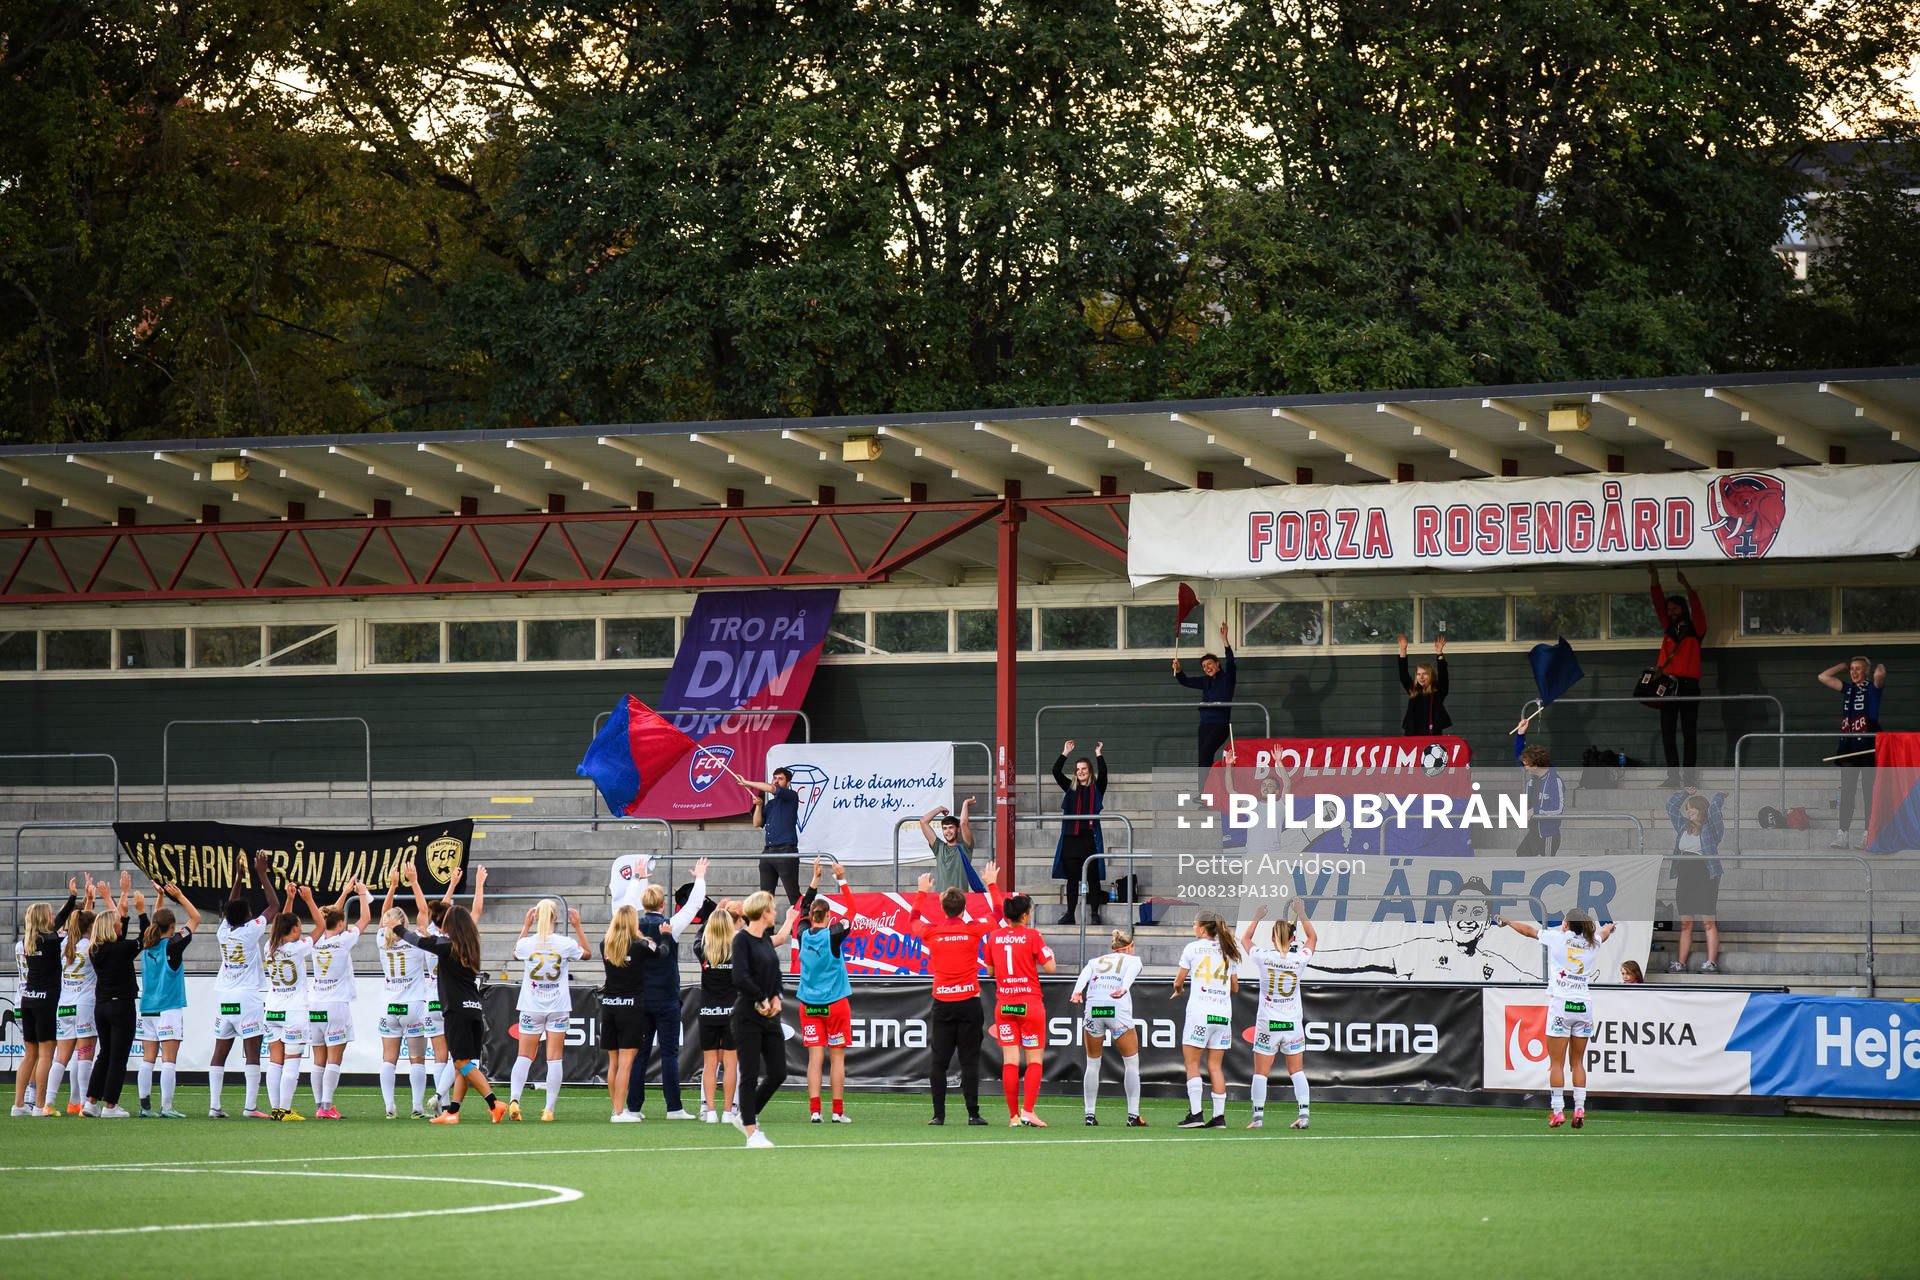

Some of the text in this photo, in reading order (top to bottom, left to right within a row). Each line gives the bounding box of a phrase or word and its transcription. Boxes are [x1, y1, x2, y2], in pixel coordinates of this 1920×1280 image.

[1248, 480, 1696, 562] FORZA ROSENGÅRD
[710, 610, 806, 641] TRO PÅ
[685, 650, 800, 697] DIN
[673, 699, 778, 734] DRÖM
[695, 758, 725, 769] FCR
[833, 773, 947, 789] Like diamonds
[833, 794, 915, 811] in the sky...
[432, 850, 455, 861] FCR
[1293, 858, 1617, 927] VI ÄR FCR
[851, 910, 900, 934] sengård
[842, 936, 867, 961] EN
[996, 935, 1026, 944] MUŠOVIĆ
[220, 943, 246, 964] 14
[317, 950, 333, 976] 9
[386, 952, 406, 977] 11
[1004, 945, 1013, 975] 1
[1095, 956, 1125, 974] 51
[1567, 947, 1584, 974] 5
[264, 960, 298, 986] 20
[529, 953, 561, 980] 23
[1194, 955, 1228, 986] 44
[936, 984, 974, 994] stadium
[1267, 968, 1297, 997] 10
[602, 997, 634, 1006] stadium
[1589, 1021, 1697, 1046] VENSKA
[1816, 1013, 1920, 1080] Heja
[1587, 1050, 1635, 1073] PEL
